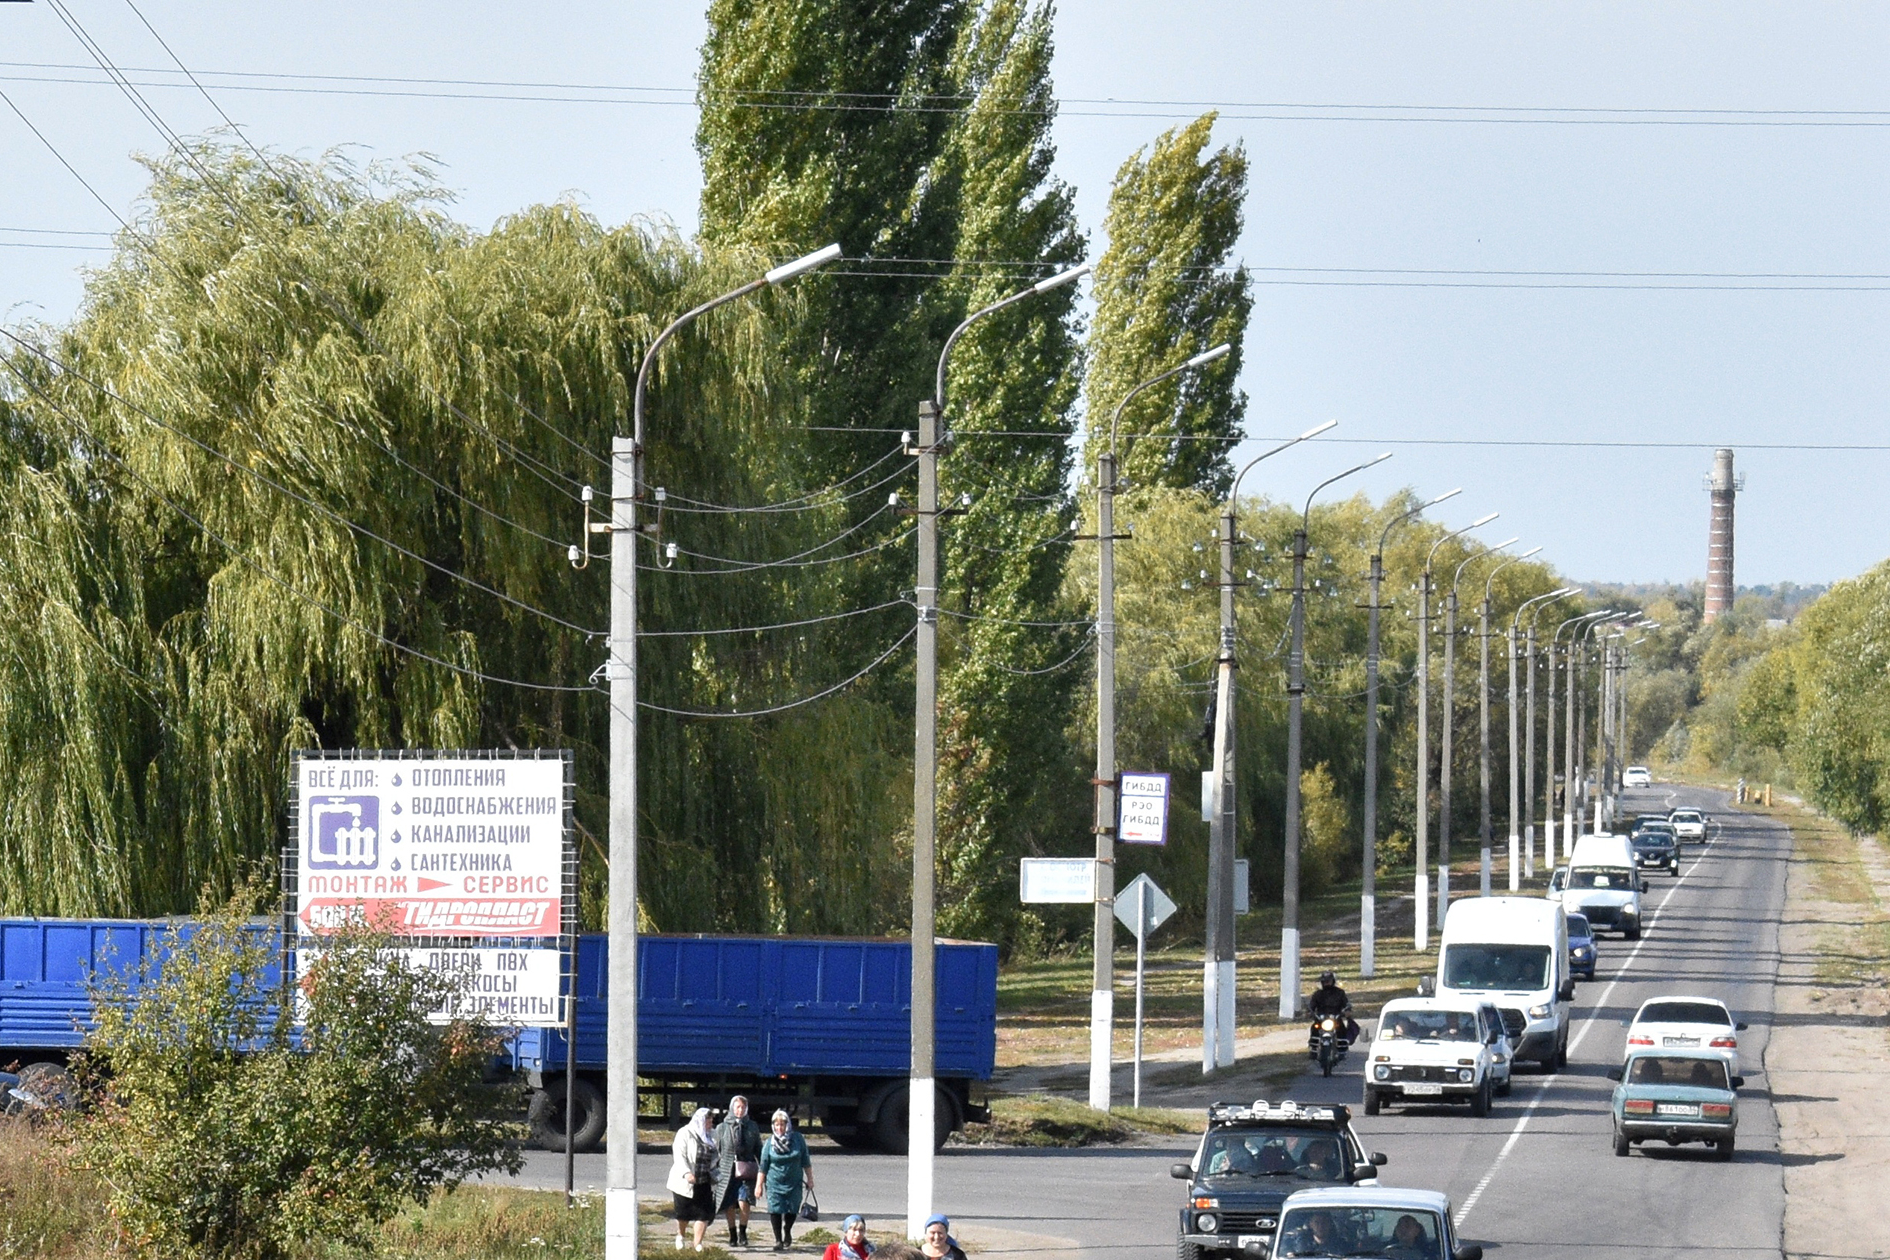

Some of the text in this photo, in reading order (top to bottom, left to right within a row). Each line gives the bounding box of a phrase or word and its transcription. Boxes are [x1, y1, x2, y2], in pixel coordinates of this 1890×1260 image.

[308, 766, 379, 790] ВСЁ ДЛЯ:
[411, 768, 506, 787] ОТОПЛЕНИЯ
[1125, 781, 1162, 793] ГИБДД
[411, 797, 557, 816] ВОДОСНАБЖЕНИЯ
[1131, 801, 1153, 811] РЭО
[1122, 814, 1160, 826] ГИБДД
[411, 825, 531, 846] КАНАЛИЗАЦИИ
[410, 853, 513, 872] САНТЕХНИКА
[308, 876, 549, 894] МОНТАЖ СЕРВИС
[429, 952, 482, 973] ДВЕРИ
[497, 952, 529, 971] ПВХ
[451, 974, 518, 992] ОКОСЫ
[468, 996, 554, 1015] ЭЛЕМЕНТЫ
